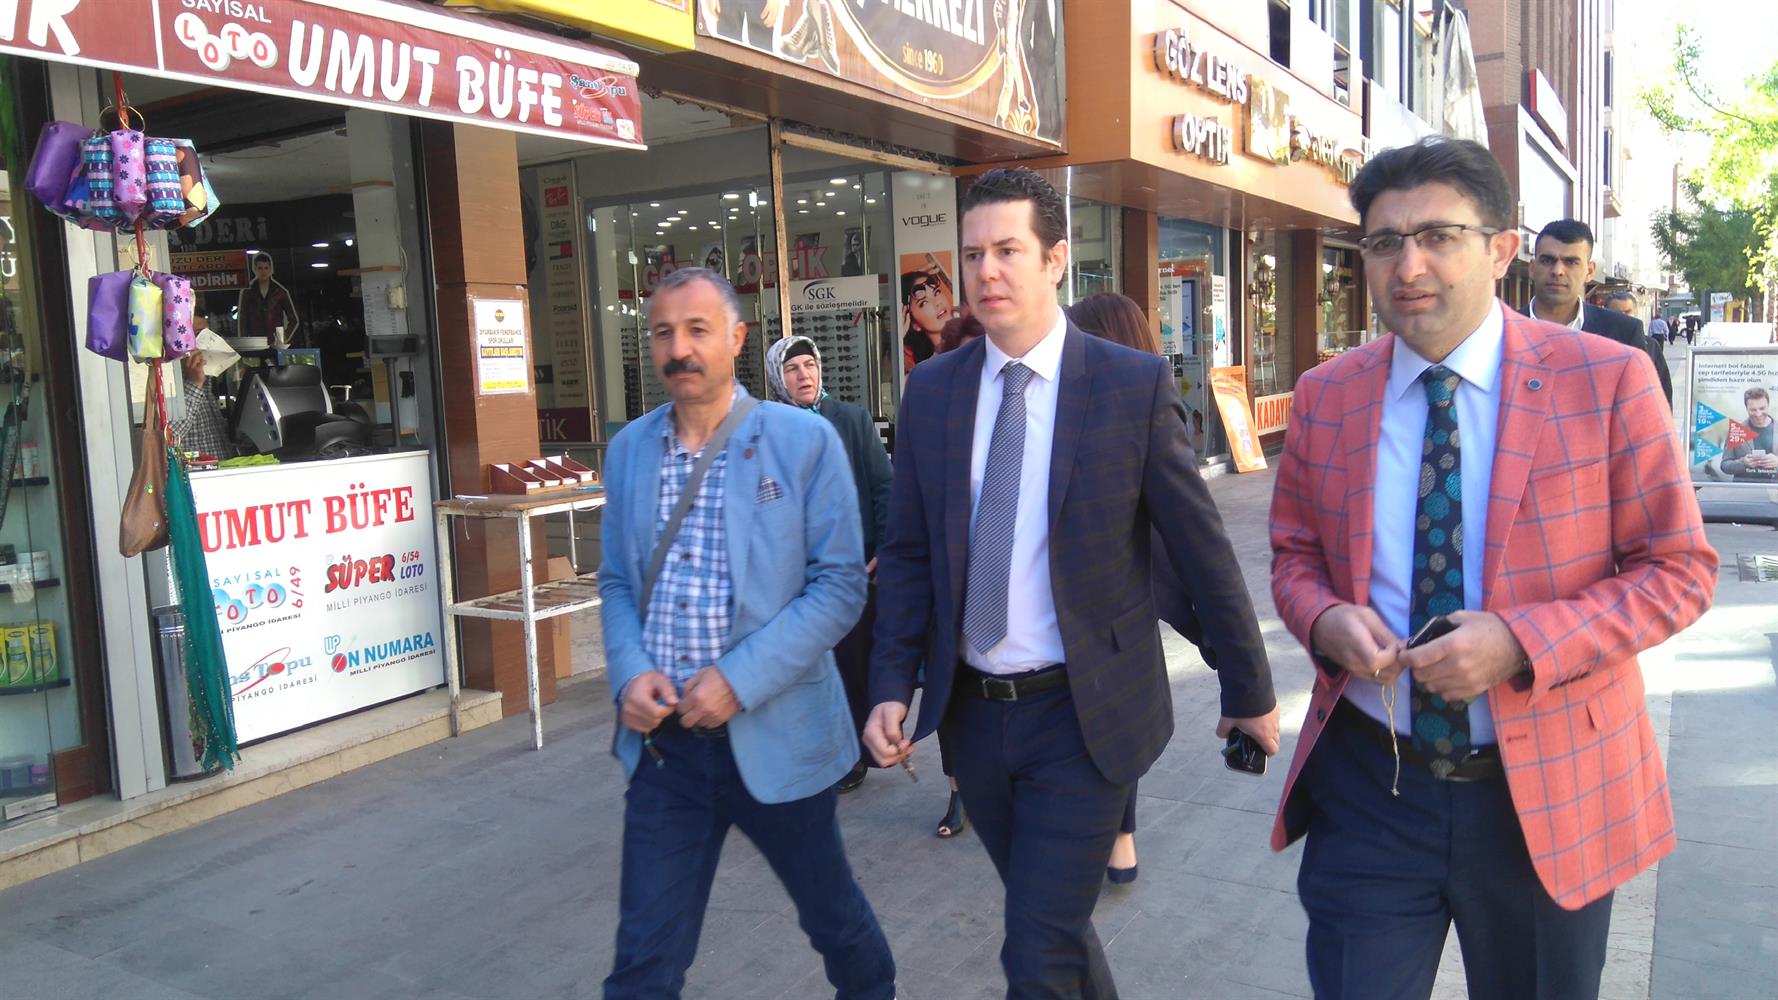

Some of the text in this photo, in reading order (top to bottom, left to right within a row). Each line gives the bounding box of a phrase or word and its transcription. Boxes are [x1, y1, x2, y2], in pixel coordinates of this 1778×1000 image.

[183, 19, 268, 63] LOTO
[288, 19, 563, 127] UMUT BÜFE
[903, 42, 944, 75] since 1960
[1155, 28, 1248, 104] GÖZ LENS
[808, 287, 836, 300] SGK
[816, 299, 868, 309] sözleşmelidir
[197, 483, 415, 553] UMUT BÜFE
[213, 568, 281, 588] SAYISAL
[324, 554, 396, 594] SÜPER
[400, 563, 424, 580] LOTO
[364, 632, 434, 663] NUMARA
